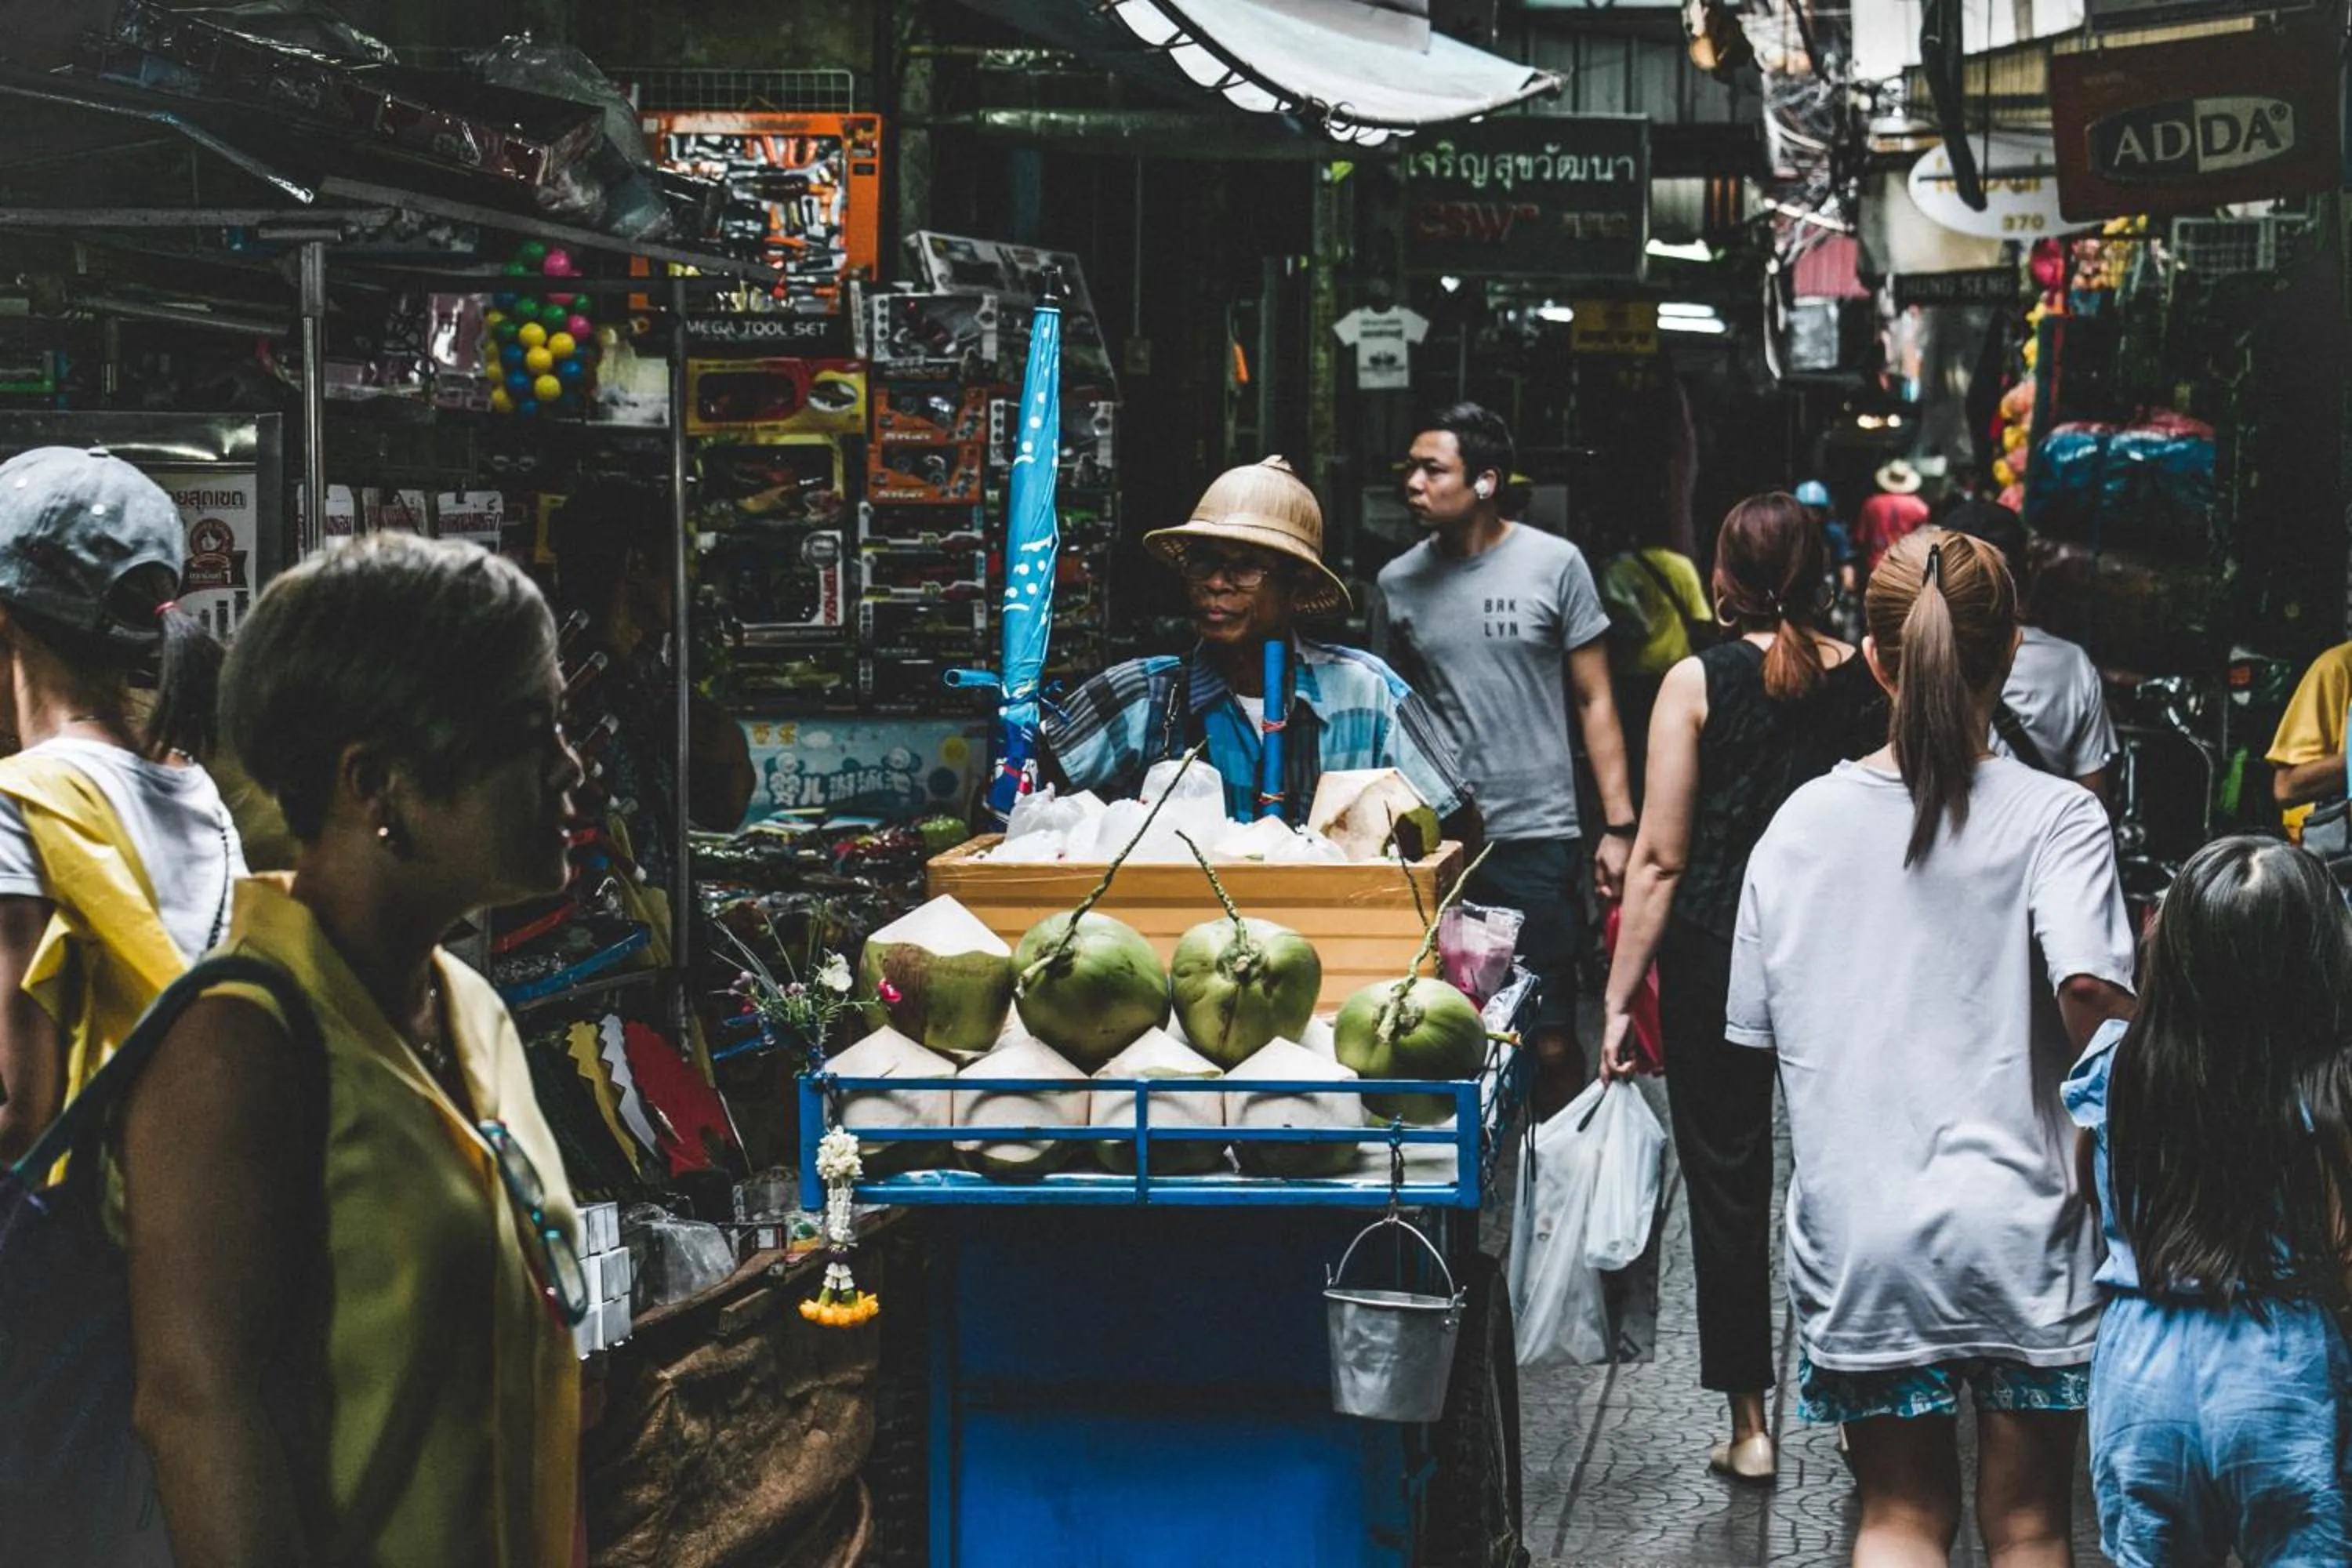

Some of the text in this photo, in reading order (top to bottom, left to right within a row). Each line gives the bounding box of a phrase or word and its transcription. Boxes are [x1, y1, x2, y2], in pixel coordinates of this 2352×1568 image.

[1408, 140, 1636, 191] เจริญสุขวัฒนา
[743, 321, 787, 336] TOOL
[793, 321, 829, 336] SET
[1484, 598, 1516, 613] BRK
[1484, 621, 1519, 637] LYN
